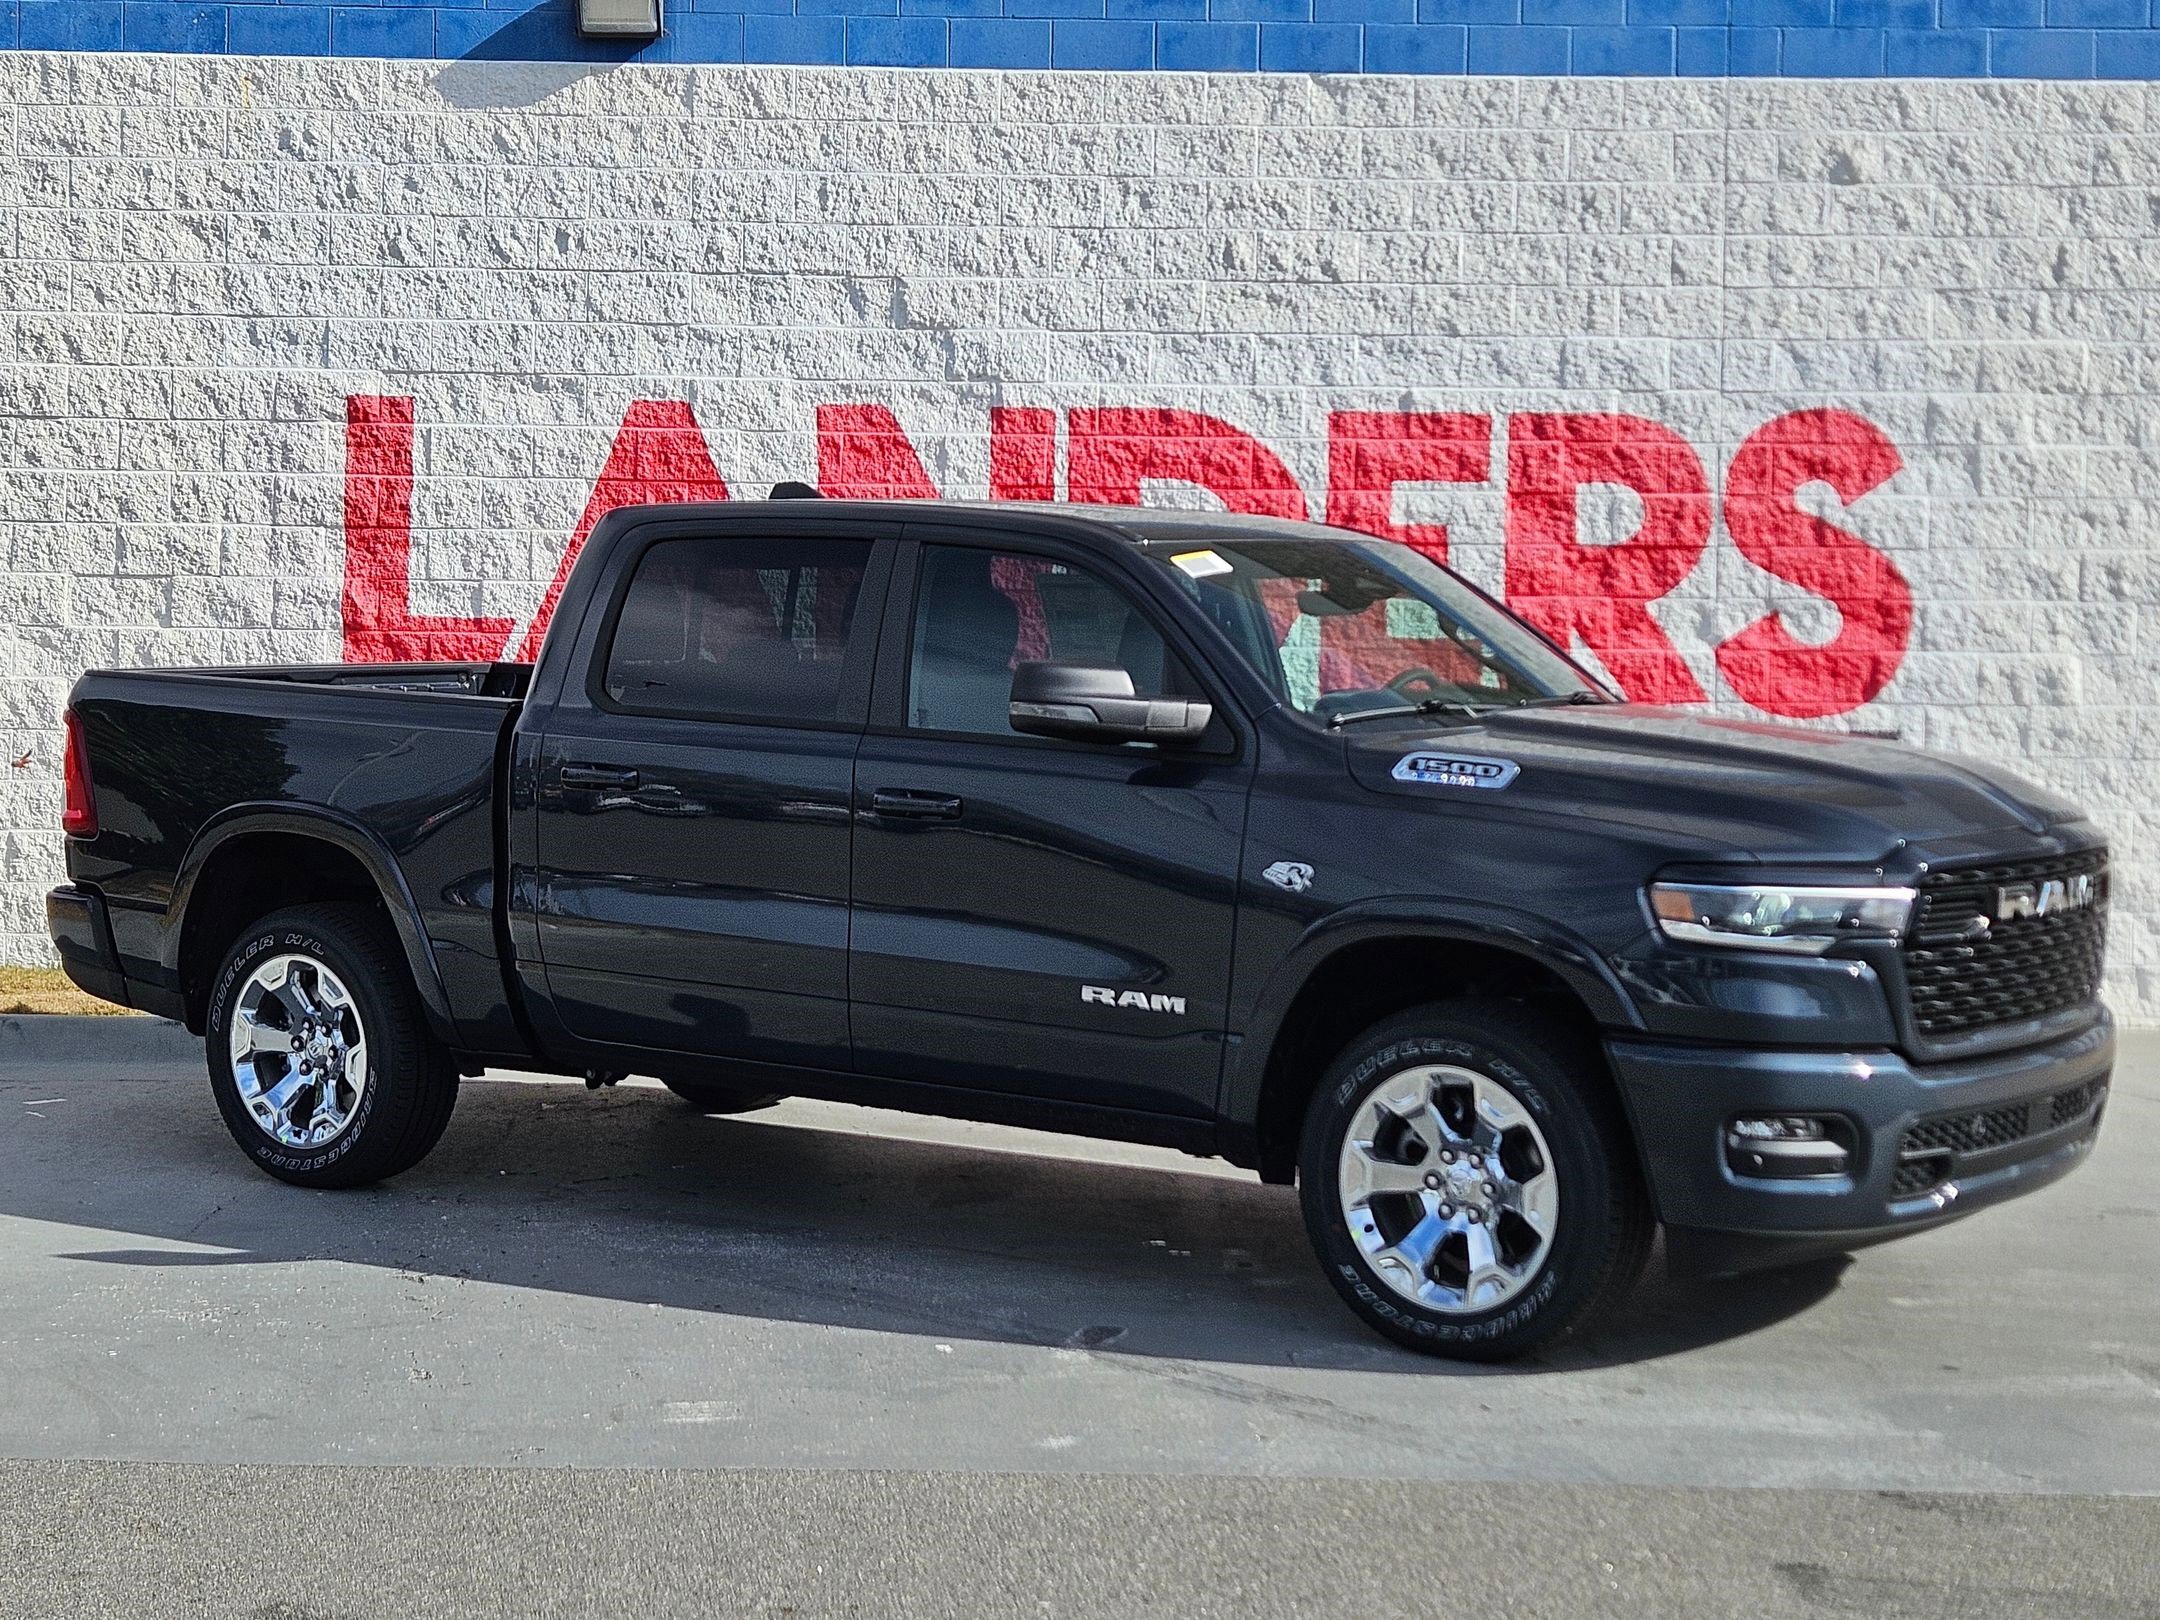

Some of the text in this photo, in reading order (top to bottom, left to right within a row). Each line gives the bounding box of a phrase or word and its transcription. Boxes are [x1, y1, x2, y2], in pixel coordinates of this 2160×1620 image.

[1408, 757, 1503, 778] 1500
[1998, 873, 2096, 920] RAM
[211, 933, 325, 1033] DUELER H/L
[1081, 984, 1187, 1016] RAM
[257, 1066, 378, 1171] BRIDGESTONE
